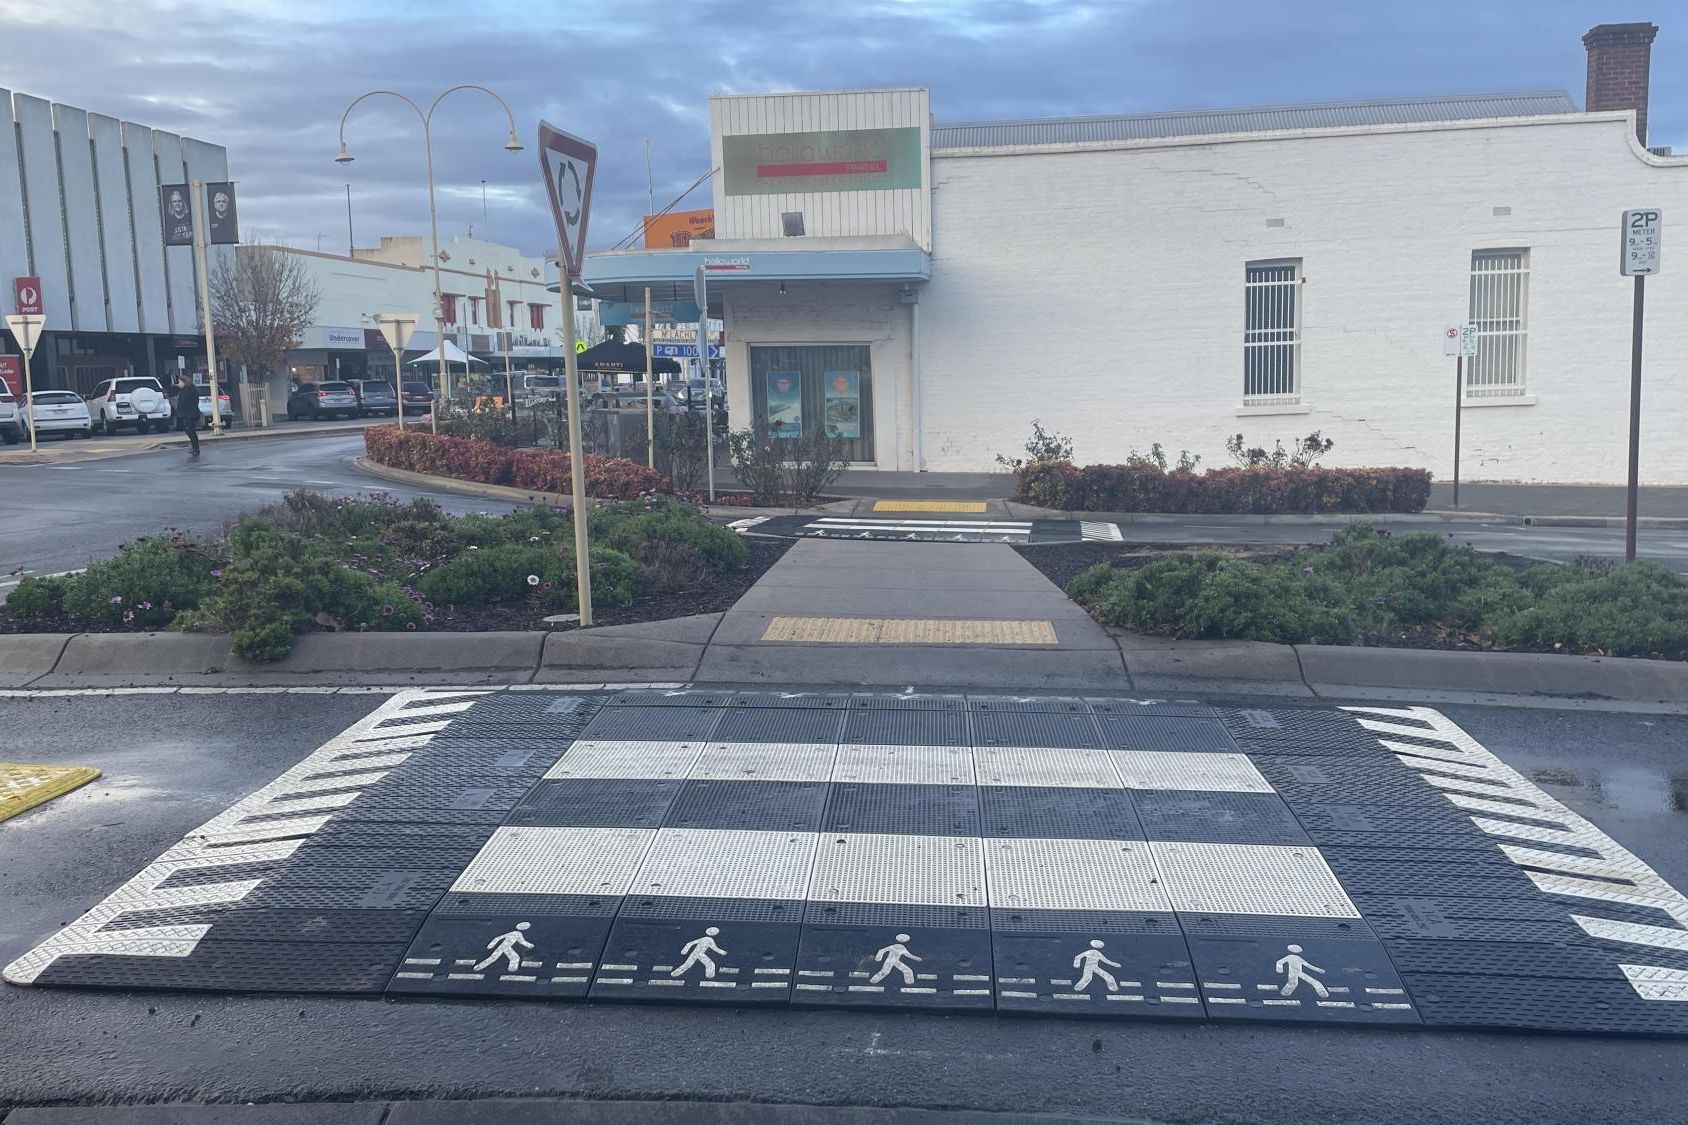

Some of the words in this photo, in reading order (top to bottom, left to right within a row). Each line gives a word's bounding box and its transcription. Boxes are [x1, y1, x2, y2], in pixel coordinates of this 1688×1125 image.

[1631, 212, 1659, 228] 2P
[1462, 327, 1477, 336] 2P
[656, 345, 662, 356] P
